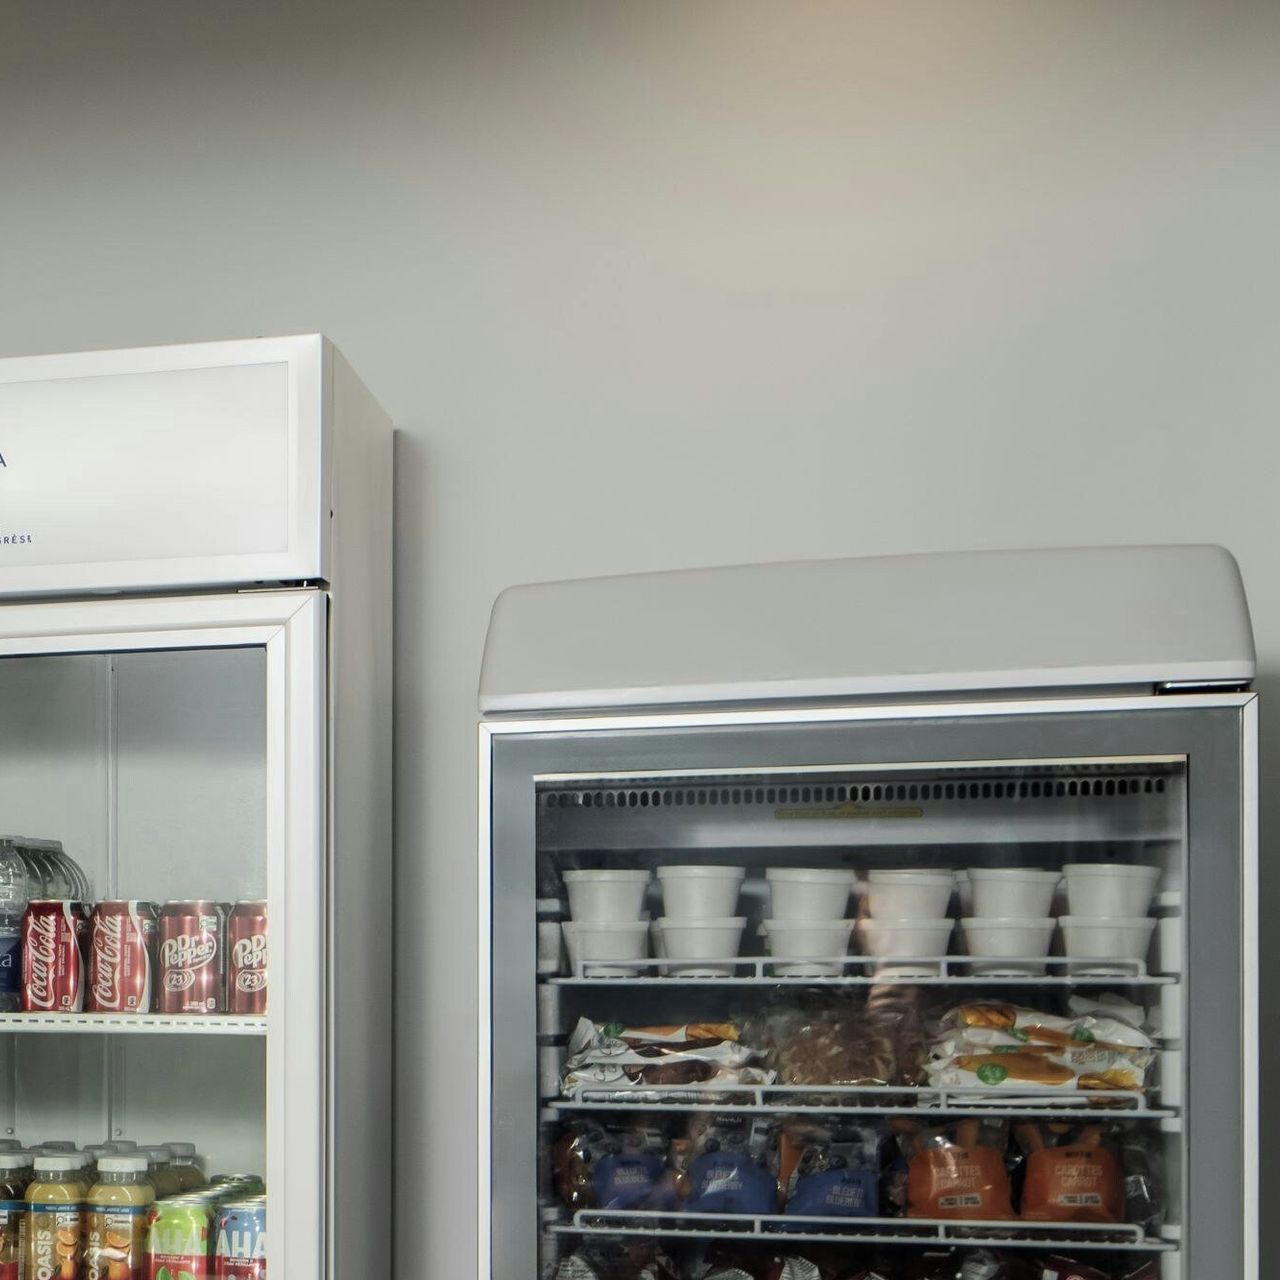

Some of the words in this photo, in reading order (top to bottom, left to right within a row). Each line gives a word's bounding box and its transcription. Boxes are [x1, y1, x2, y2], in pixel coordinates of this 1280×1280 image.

[177, 934, 199, 947] Dr
[163, 939, 213, 968] Pepper
[171, 974, 183, 985] 23
[244, 974, 257, 986] 23
[146, 1227, 201, 1255] AHA
[216, 1229, 267, 1258] AHA
